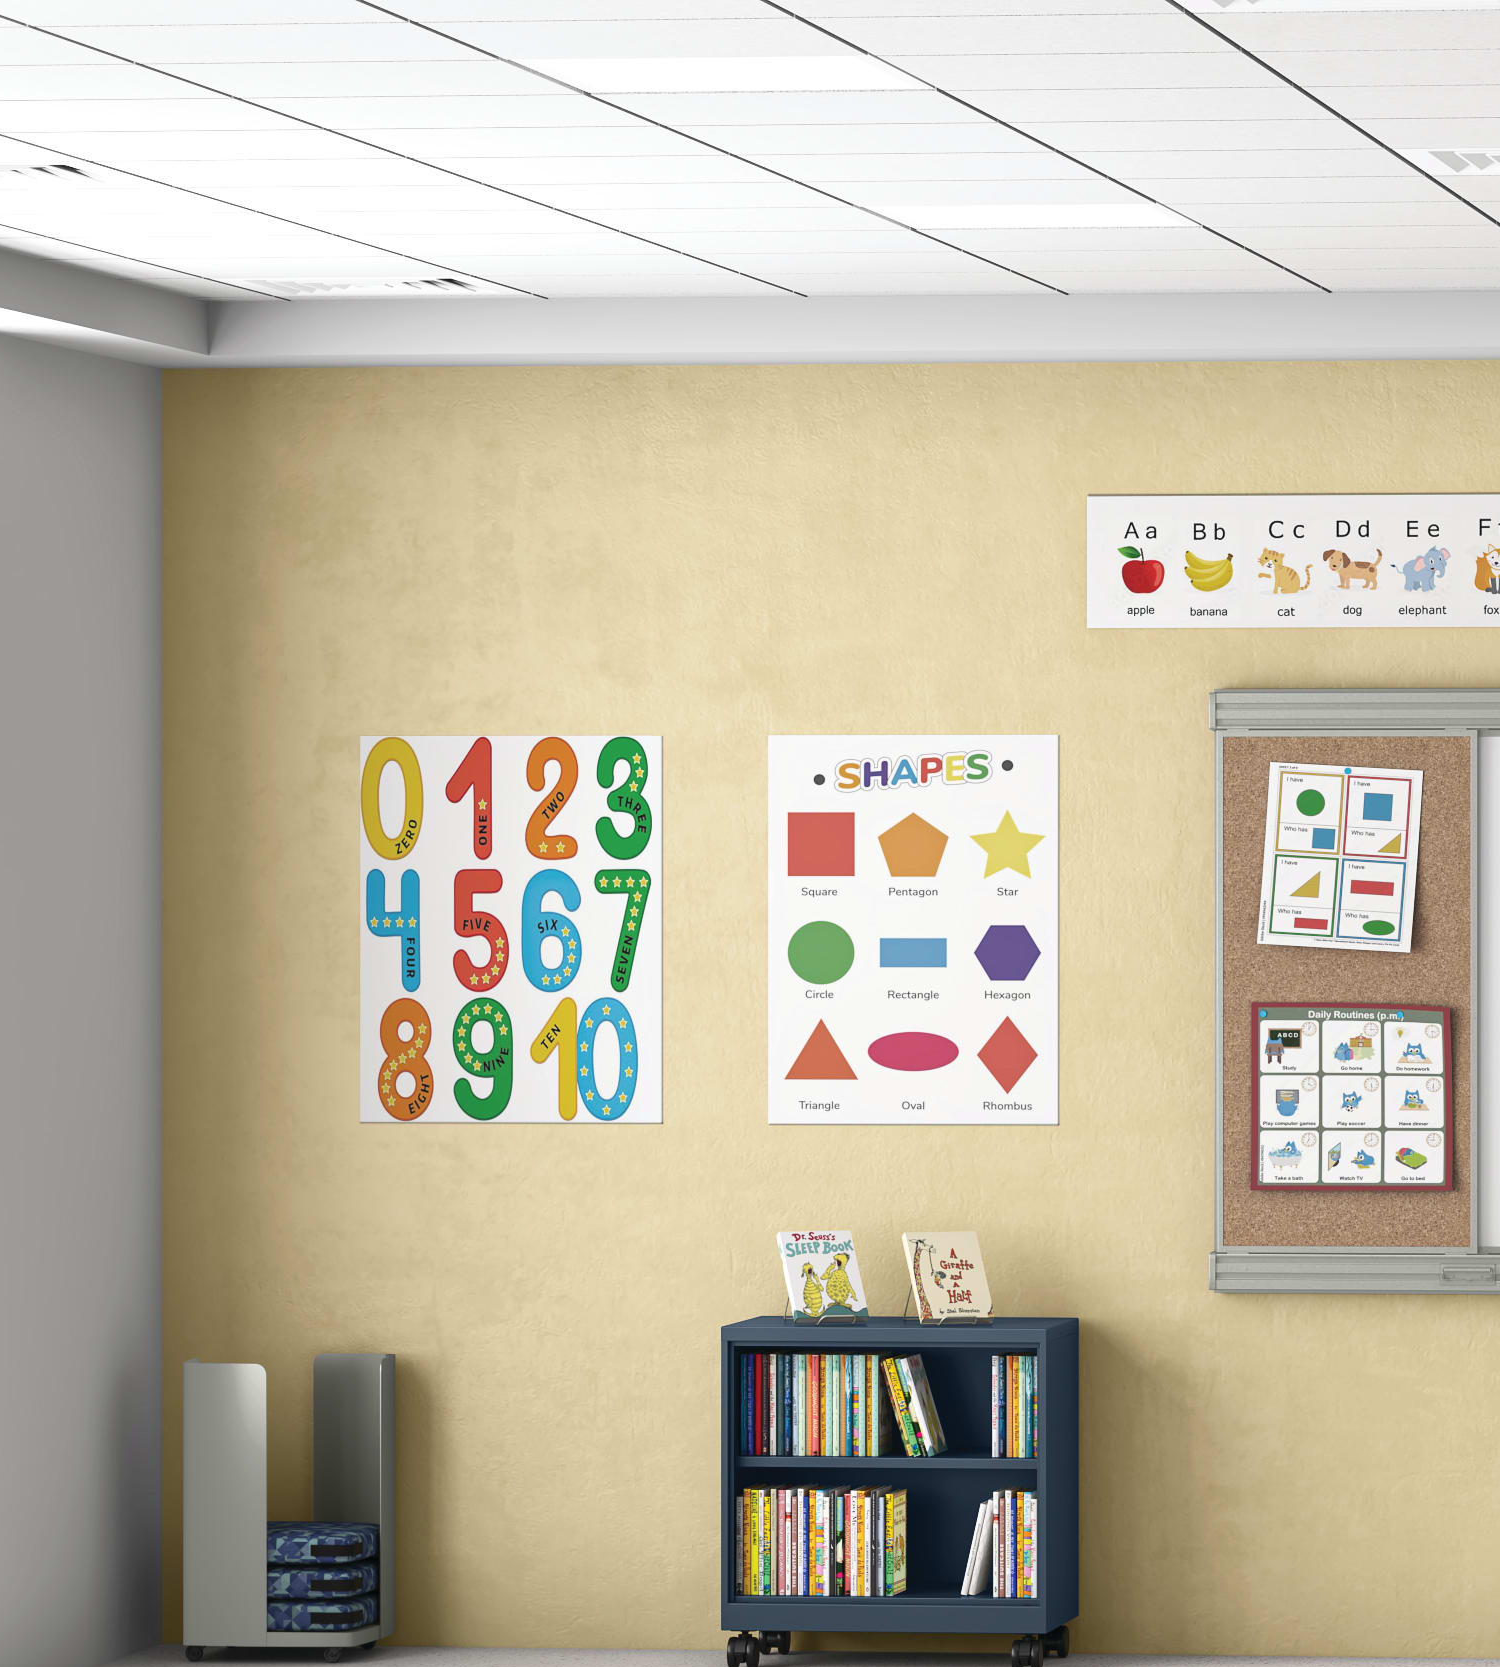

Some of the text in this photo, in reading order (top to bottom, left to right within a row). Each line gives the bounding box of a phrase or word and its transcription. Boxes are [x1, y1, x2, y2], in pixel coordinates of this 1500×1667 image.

[1127, 605, 1155, 616] apple
[1190, 607, 1227, 616] banana
[1277, 608, 1295, 616] cat
[1343, 605, 1362, 616] dog
[1399, 605, 1447, 616] elephant
[1484, 605, 1499, 614] fox
[837, 753, 989, 790] SHAPES
[361, 737, 424, 860] 0
[445, 736, 492, 860] 1
[525, 736, 578, 860] 2
[541, 791, 565, 820] TWO
[595, 736, 652, 860] 3
[617, 795, 648, 834] THREE
[395, 819, 418, 854] ZERO
[479, 815, 488, 846] ONE
[801, 887, 838, 899] Square
[888, 886, 939, 899] Pentagon
[996, 887, 1019, 897] Star
[366, 869, 420, 992] 4
[453, 869, 510, 992] 5
[462, 918, 492, 932] FIVE
[521, 869, 582, 992] 6
[537, 919, 559, 934] SIX
[594, 869, 651, 992] 7
[406, 937, 416, 979] FOUR
[615, 935, 634, 984] SEVEN
[804, 989, 835, 1000] Circle
[887, 989, 940, 1001] Rectangle
[984, 989, 1032, 1002] Hexagon
[1308, 1010, 1331, 1020] Daily
[1333, 1011, 1375, 1019] Routines
[540, 1023, 562, 1050] TEN
[378, 998, 434, 1121] 8
[453, 997, 513, 1121] 9
[483, 1047, 510, 1073] NINE
[530, 997, 638, 1121] 10
[408, 1073, 430, 1115] EIGHT
[799, 1100, 841, 1112] Triangle
[901, 1100, 926, 1110] Oval
[982, 1100, 1034, 1112] Rhombus
[792, 1231, 836, 1241] Dr. Seuss's
[785, 1239, 855, 1257] SLEEP BOOK
[949, 1248, 958, 1259] A
[940, 1259, 975, 1271] Giraffe
[949, 1271, 963, 1280] and
[946, 1289, 972, 1304] Half
